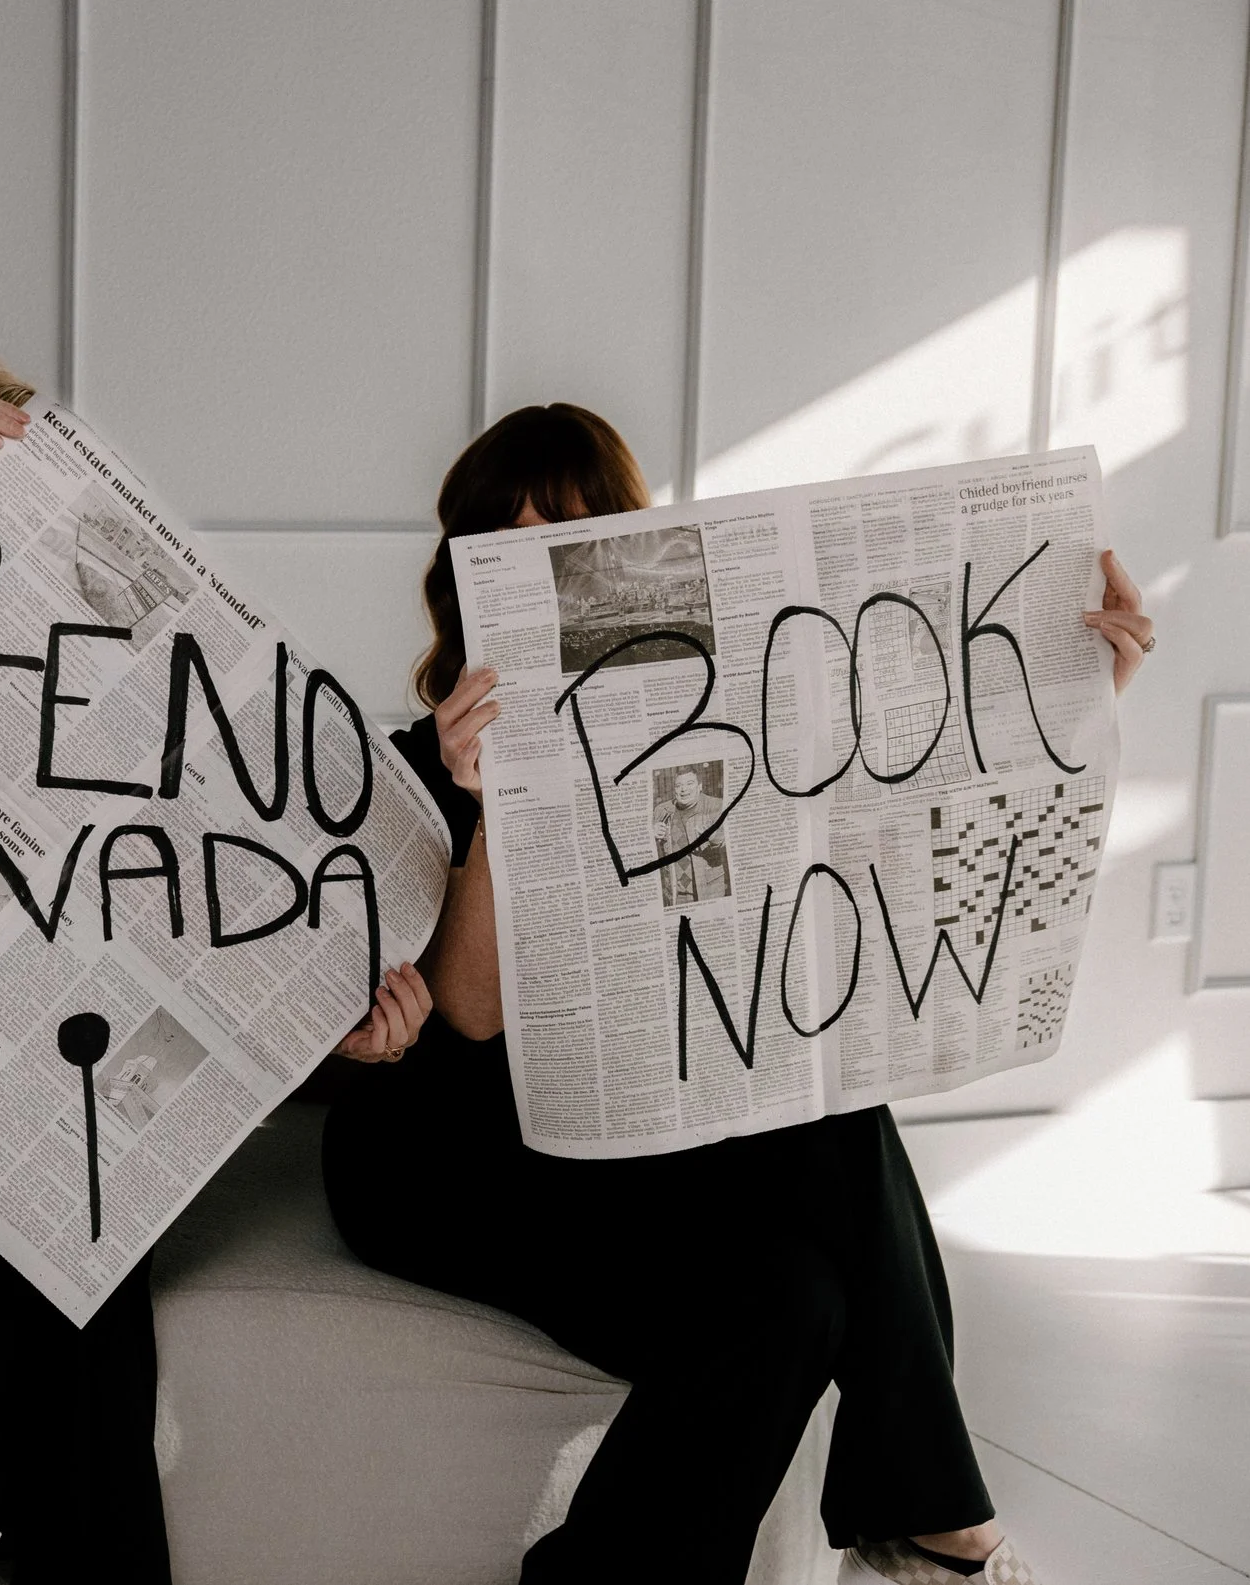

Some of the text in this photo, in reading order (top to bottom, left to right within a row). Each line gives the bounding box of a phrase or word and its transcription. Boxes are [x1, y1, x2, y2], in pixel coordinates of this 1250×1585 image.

[27, 427, 44, 443] prices
[43, 441, 55, 452] and
[52, 449, 68, 467] buyers
[66, 465, 82, 480] aren't
[33, 422, 50, 439] Sellers
[49, 437, 66, 455] setting
[64, 452, 88, 476] unrealistic
[43, 452, 60, 469] agents
[59, 467, 68, 477] say
[42, 410, 76, 441] Real
[73, 439, 112, 478] estate
[111, 478, 157, 524] market
[155, 522, 183, 551] now
[182, 547, 197, 567] in
[196, 564, 207, 577] a
[958, 472, 1088, 500] Chided boyfriend nurses
[960, 489, 1075, 516] a grudge for six years
[469, 555, 502, 566] Shows
[554, 540, 1087, 888] BOOK
[184, 762, 206, 786] Gerth
[497, 785, 528, 797] Events
[385, 758, 395, 771] to
[393, 768, 407, 786] the
[405, 783, 432, 819] moment
[430, 818, 439, 829] of
[10, 821, 46, 857] famine
[678, 833, 1018, 1081] NOW
